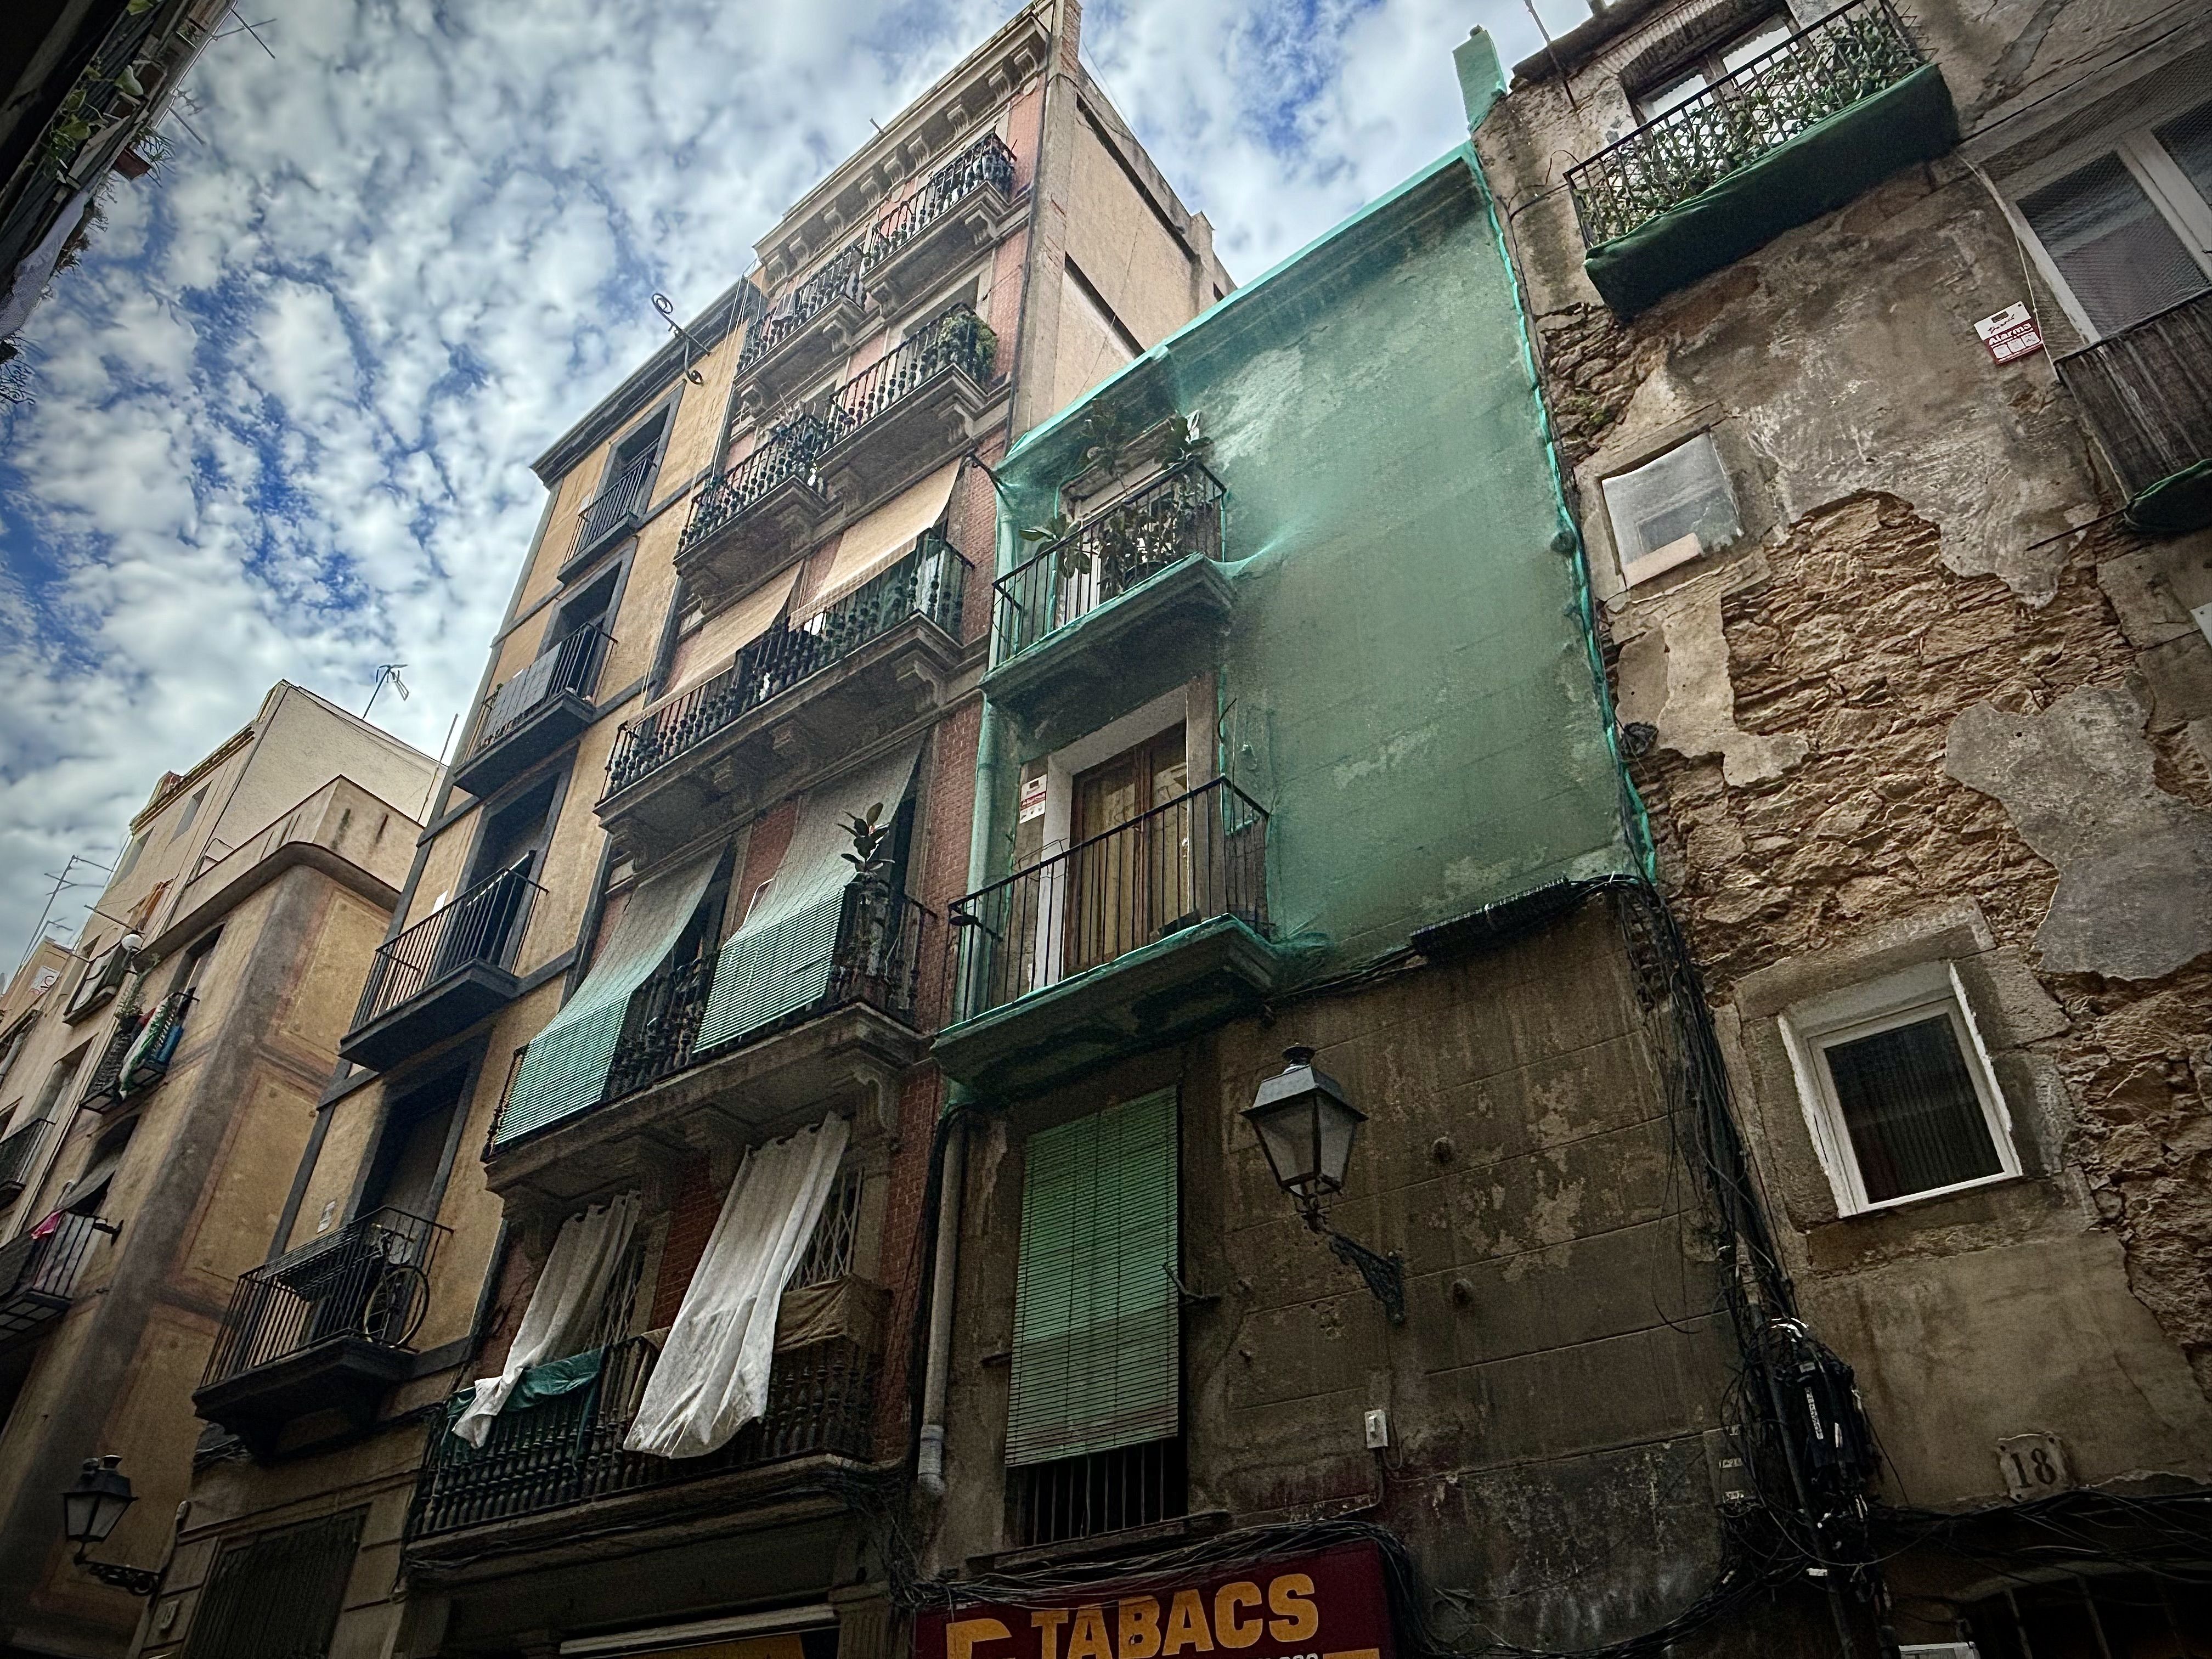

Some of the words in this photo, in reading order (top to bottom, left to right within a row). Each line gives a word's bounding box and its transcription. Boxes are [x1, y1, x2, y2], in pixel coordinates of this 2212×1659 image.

[1989, 323, 2032, 346] Alarma
[2010, 1448, 2057, 1489] 18
[1031, 1573, 1318, 1659] TABACS
